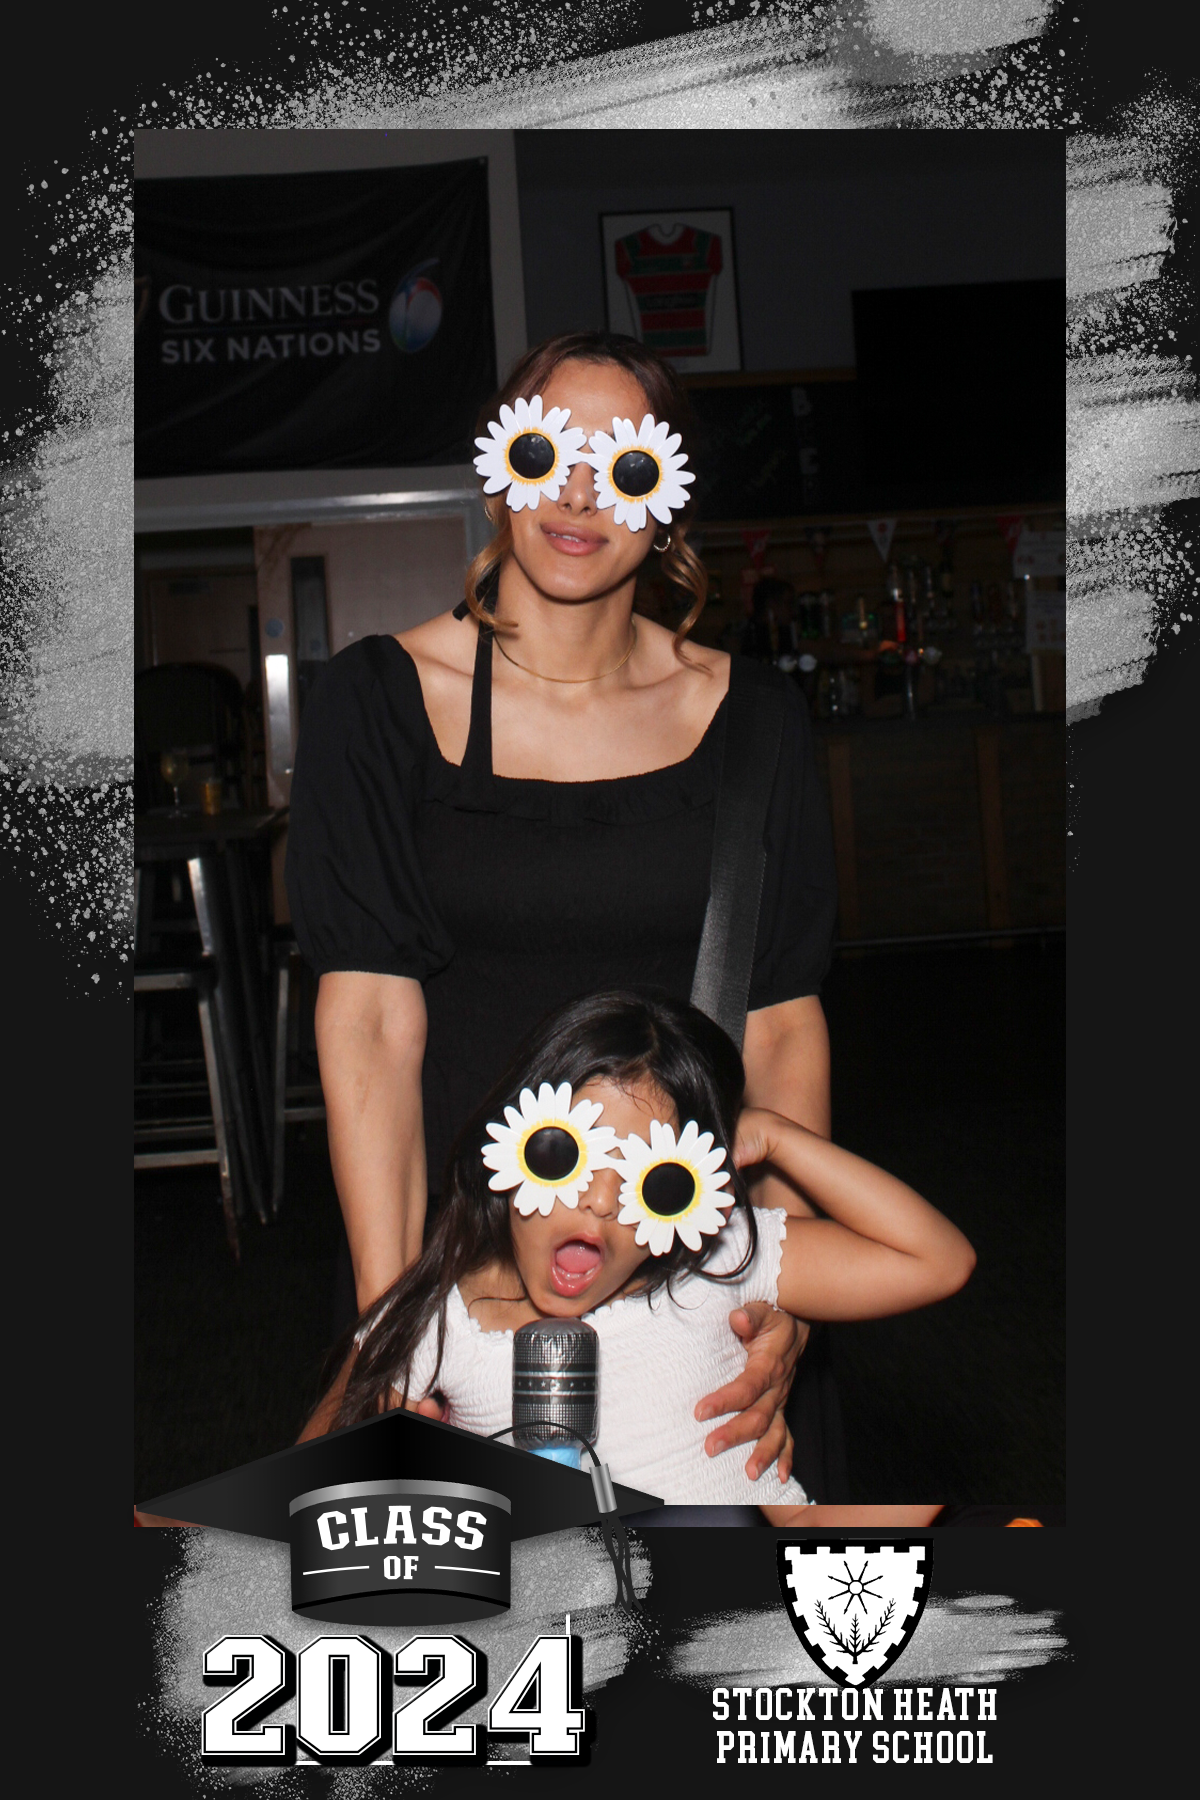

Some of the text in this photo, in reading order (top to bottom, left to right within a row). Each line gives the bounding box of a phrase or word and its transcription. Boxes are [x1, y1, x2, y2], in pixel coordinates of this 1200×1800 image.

[158, 279, 380, 324] GUINNESS
[161, 328, 382, 365] SIX NATIONS
